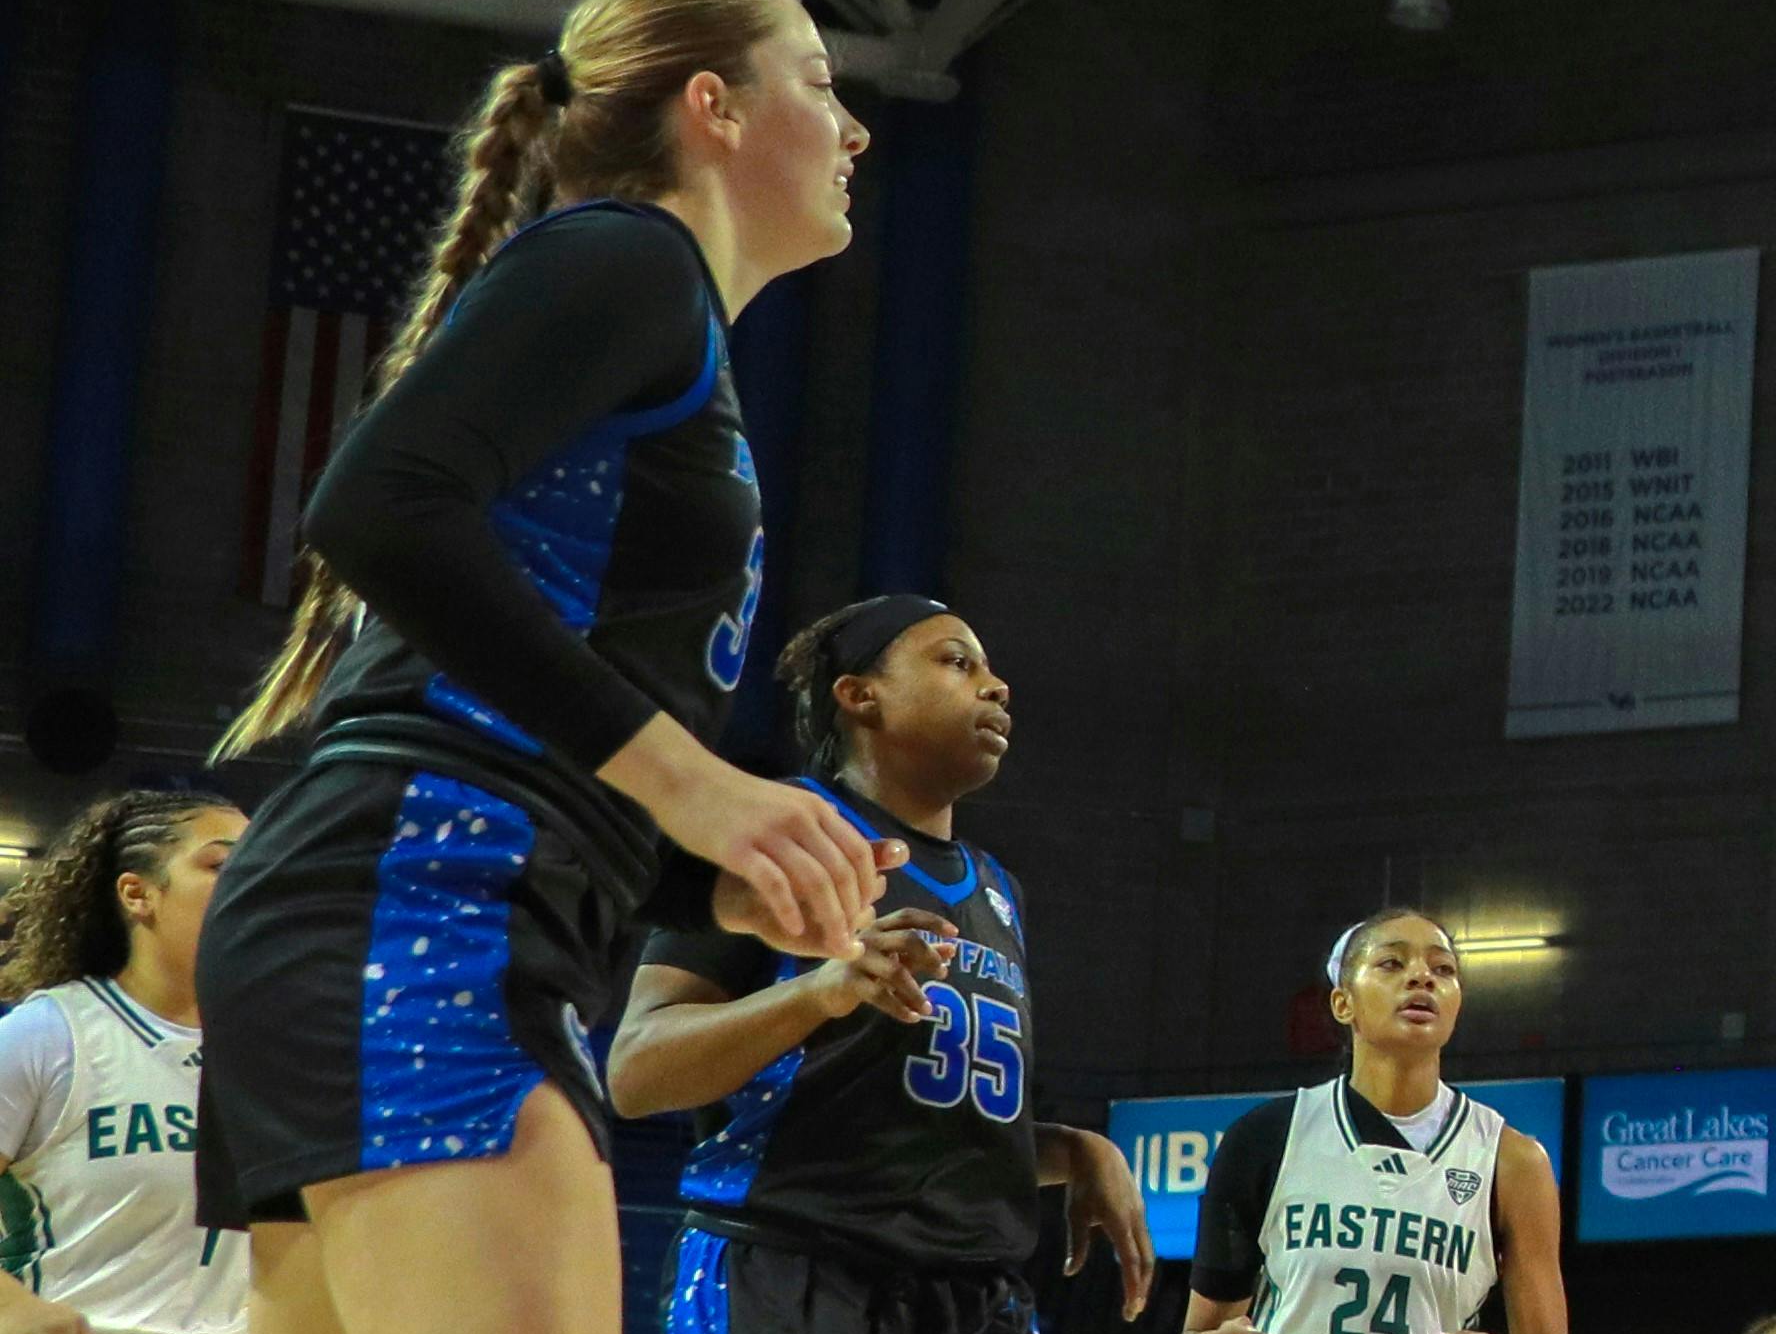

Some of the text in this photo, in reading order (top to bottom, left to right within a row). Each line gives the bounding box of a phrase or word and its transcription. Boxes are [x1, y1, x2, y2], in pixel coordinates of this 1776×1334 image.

[1631, 500, 1704, 527] NCAA
[1630, 528, 1702, 555] NCAA
[1629, 557, 1701, 584] NCAA
[1629, 585, 1699, 612] NCAA
[904, 978, 1027, 1124] 35
[1602, 1105, 1769, 1144] Great Lakes
[1617, 1146, 1753, 1172] Cancer Care
[1284, 1203, 1477, 1275] EASTERN
